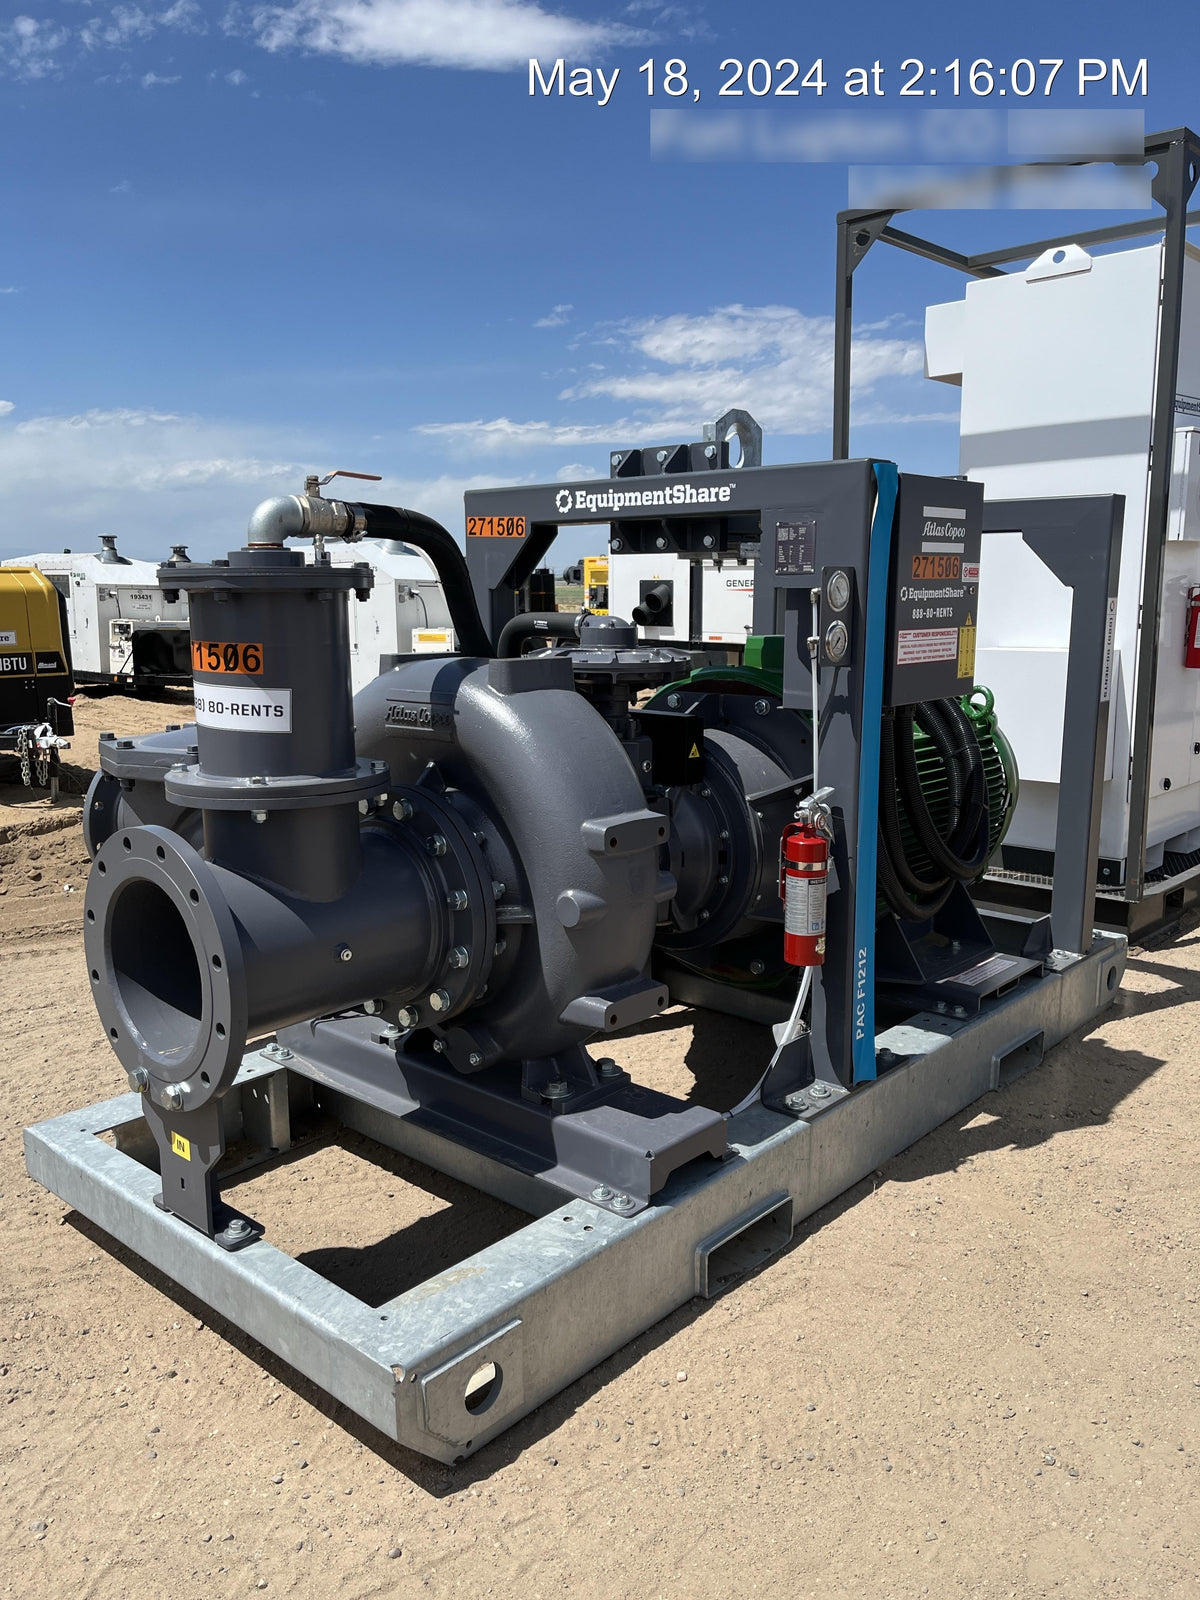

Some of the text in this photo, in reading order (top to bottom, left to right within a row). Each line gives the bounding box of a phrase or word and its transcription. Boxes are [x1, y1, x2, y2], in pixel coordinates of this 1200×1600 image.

[468, 517, 525, 537] 271506
[913, 556, 959, 577] 271506
[912, 607, 953, 619] 888-80-RENTS
[208, 701, 284, 717] 80-RENTS
[856, 947, 867, 1040] PAC F1212
[176, 1139, 185, 1152] IN
